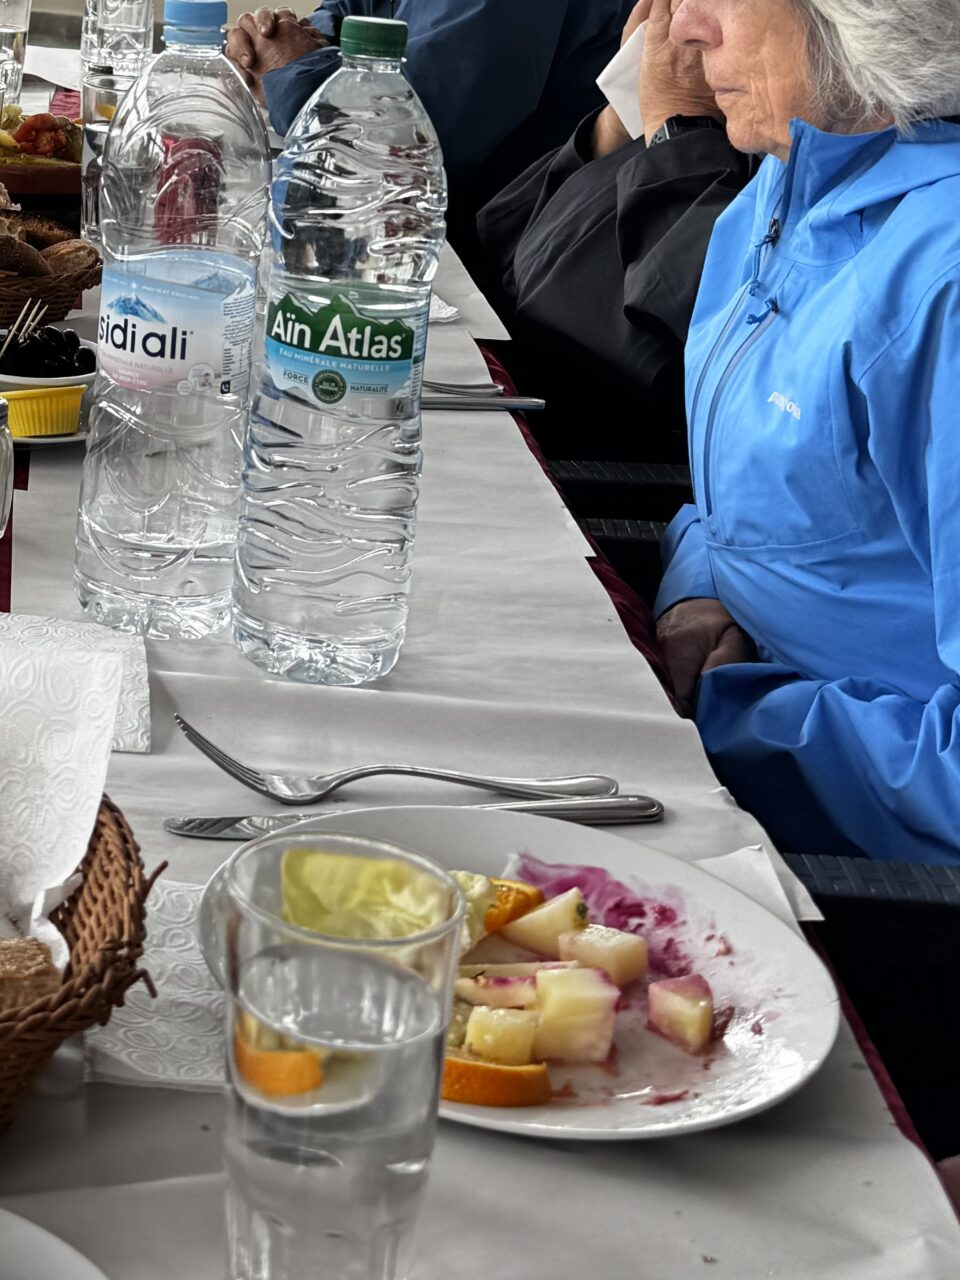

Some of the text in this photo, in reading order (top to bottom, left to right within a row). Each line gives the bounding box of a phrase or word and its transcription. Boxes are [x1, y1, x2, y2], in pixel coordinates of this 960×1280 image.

[98, 313, 137, 354] sidi
[141, 326, 189, 361] ali
[271, 309, 312, 349] Aïn
[318, 313, 403, 359] Atlas
[279, 347, 391, 372] EAU MINÉRALE NATURELLE
[283, 370, 389, 394] FORCE NATURALITÉ
